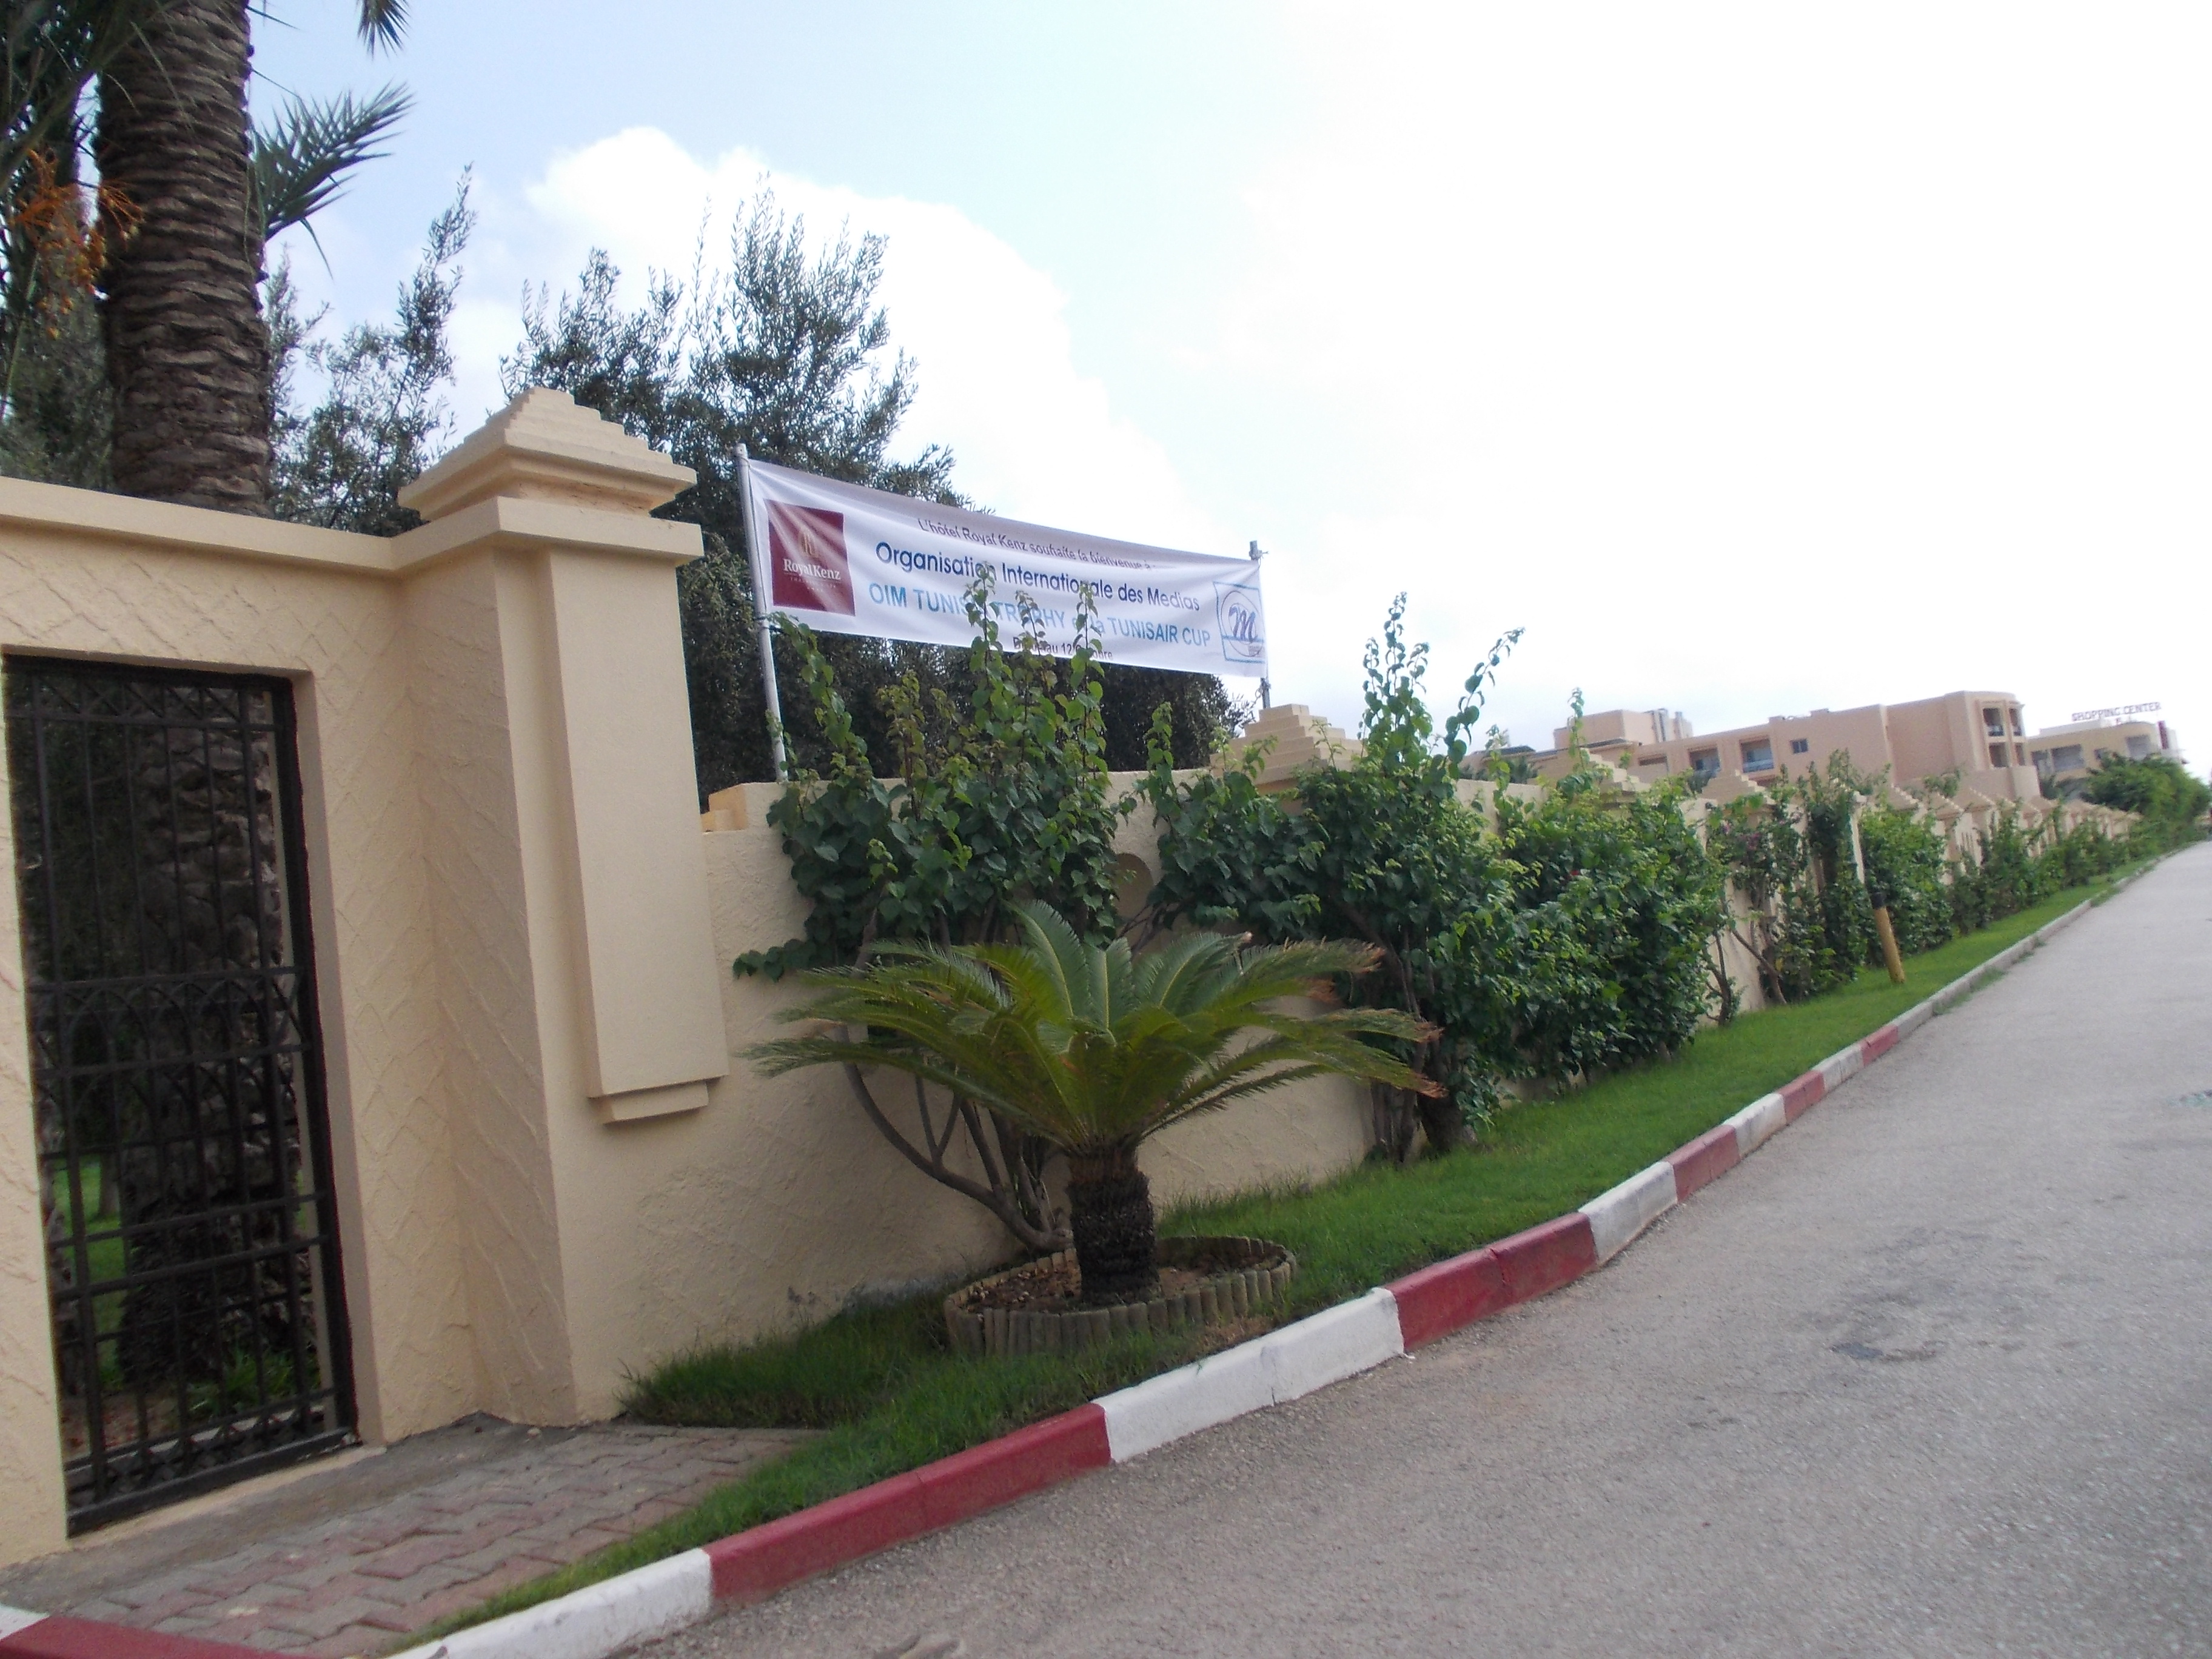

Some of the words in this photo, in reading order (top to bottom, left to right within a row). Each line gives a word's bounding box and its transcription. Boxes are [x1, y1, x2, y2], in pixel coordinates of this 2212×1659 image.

[917, 518, 960, 538] L'hôtel
[962, 527, 995, 545] Royal
[998, 534, 1028, 551] Kenz
[1030, 543, 1076, 560] souhaite
[1078, 549, 1088, 562] la
[1090, 551, 1142, 569] bienvenue
[783, 558, 813, 575] Royal
[813, 563, 841, 580] Kenz
[1002, 563, 1113, 599] Internatioale
[1118, 583, 1143, 604] des
[1147, 587, 1200, 611] Medias
[869, 583, 907, 608] OIM
[1107, 617, 1178, 643] TUNISAIR
[1182, 627, 1211, 647] CUP
[1061, 643, 1073, 655] 12
[2072, 707, 2120, 722] SHOPPING
[2123, 702, 2162, 714] CENTER
